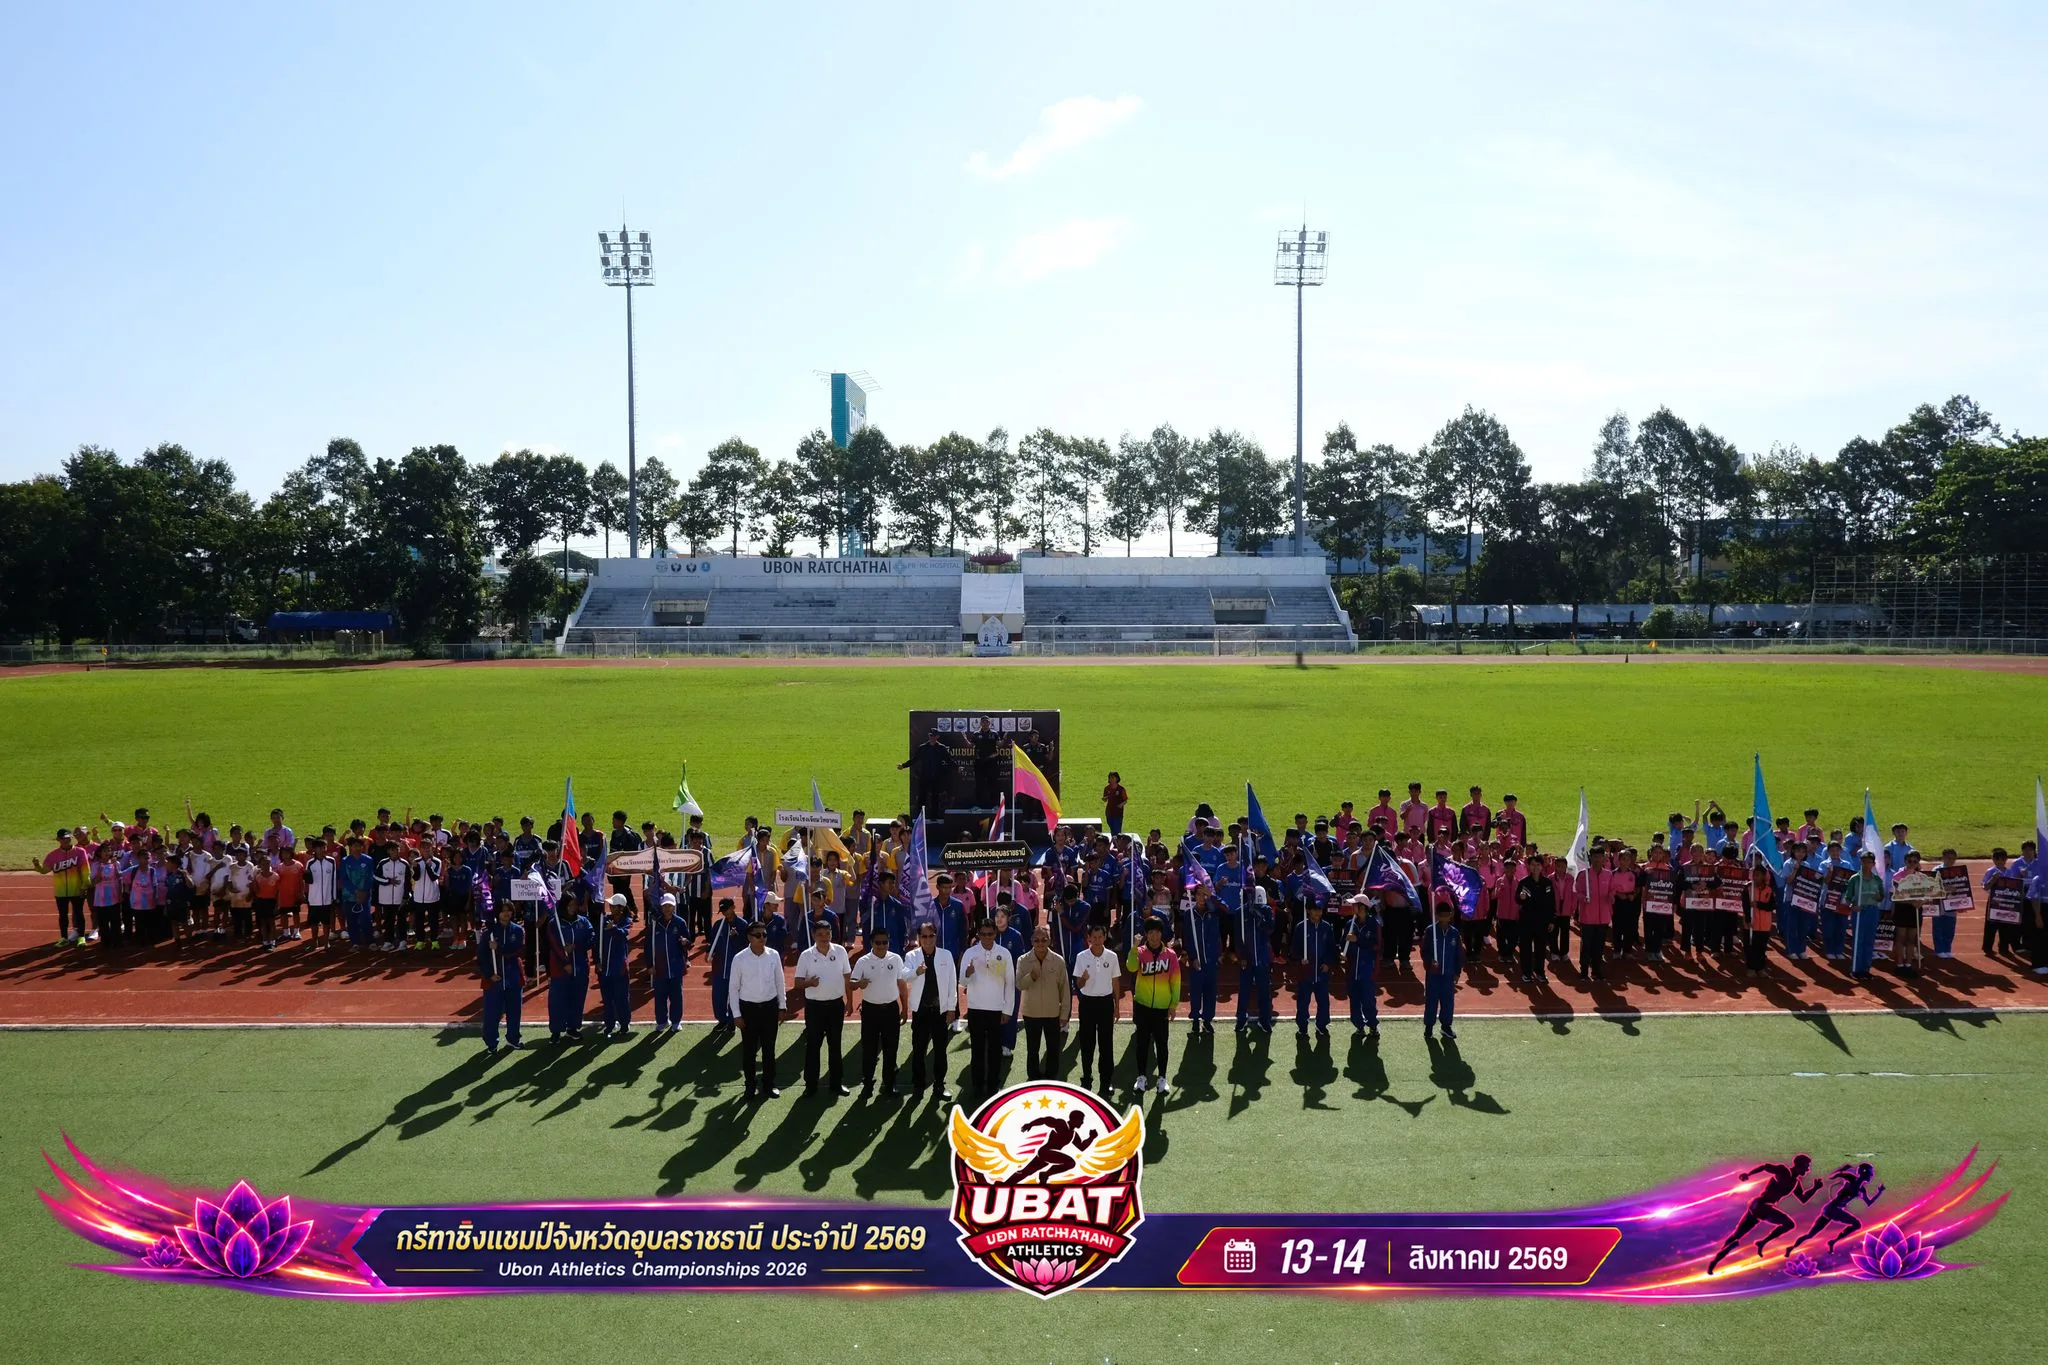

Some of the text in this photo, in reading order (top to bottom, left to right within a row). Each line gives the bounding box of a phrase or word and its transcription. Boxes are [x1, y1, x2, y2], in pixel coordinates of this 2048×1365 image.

[763, 560, 803, 574] UBON
[53, 855, 78, 872] UBN
[1141, 958, 1169, 974] UBN
